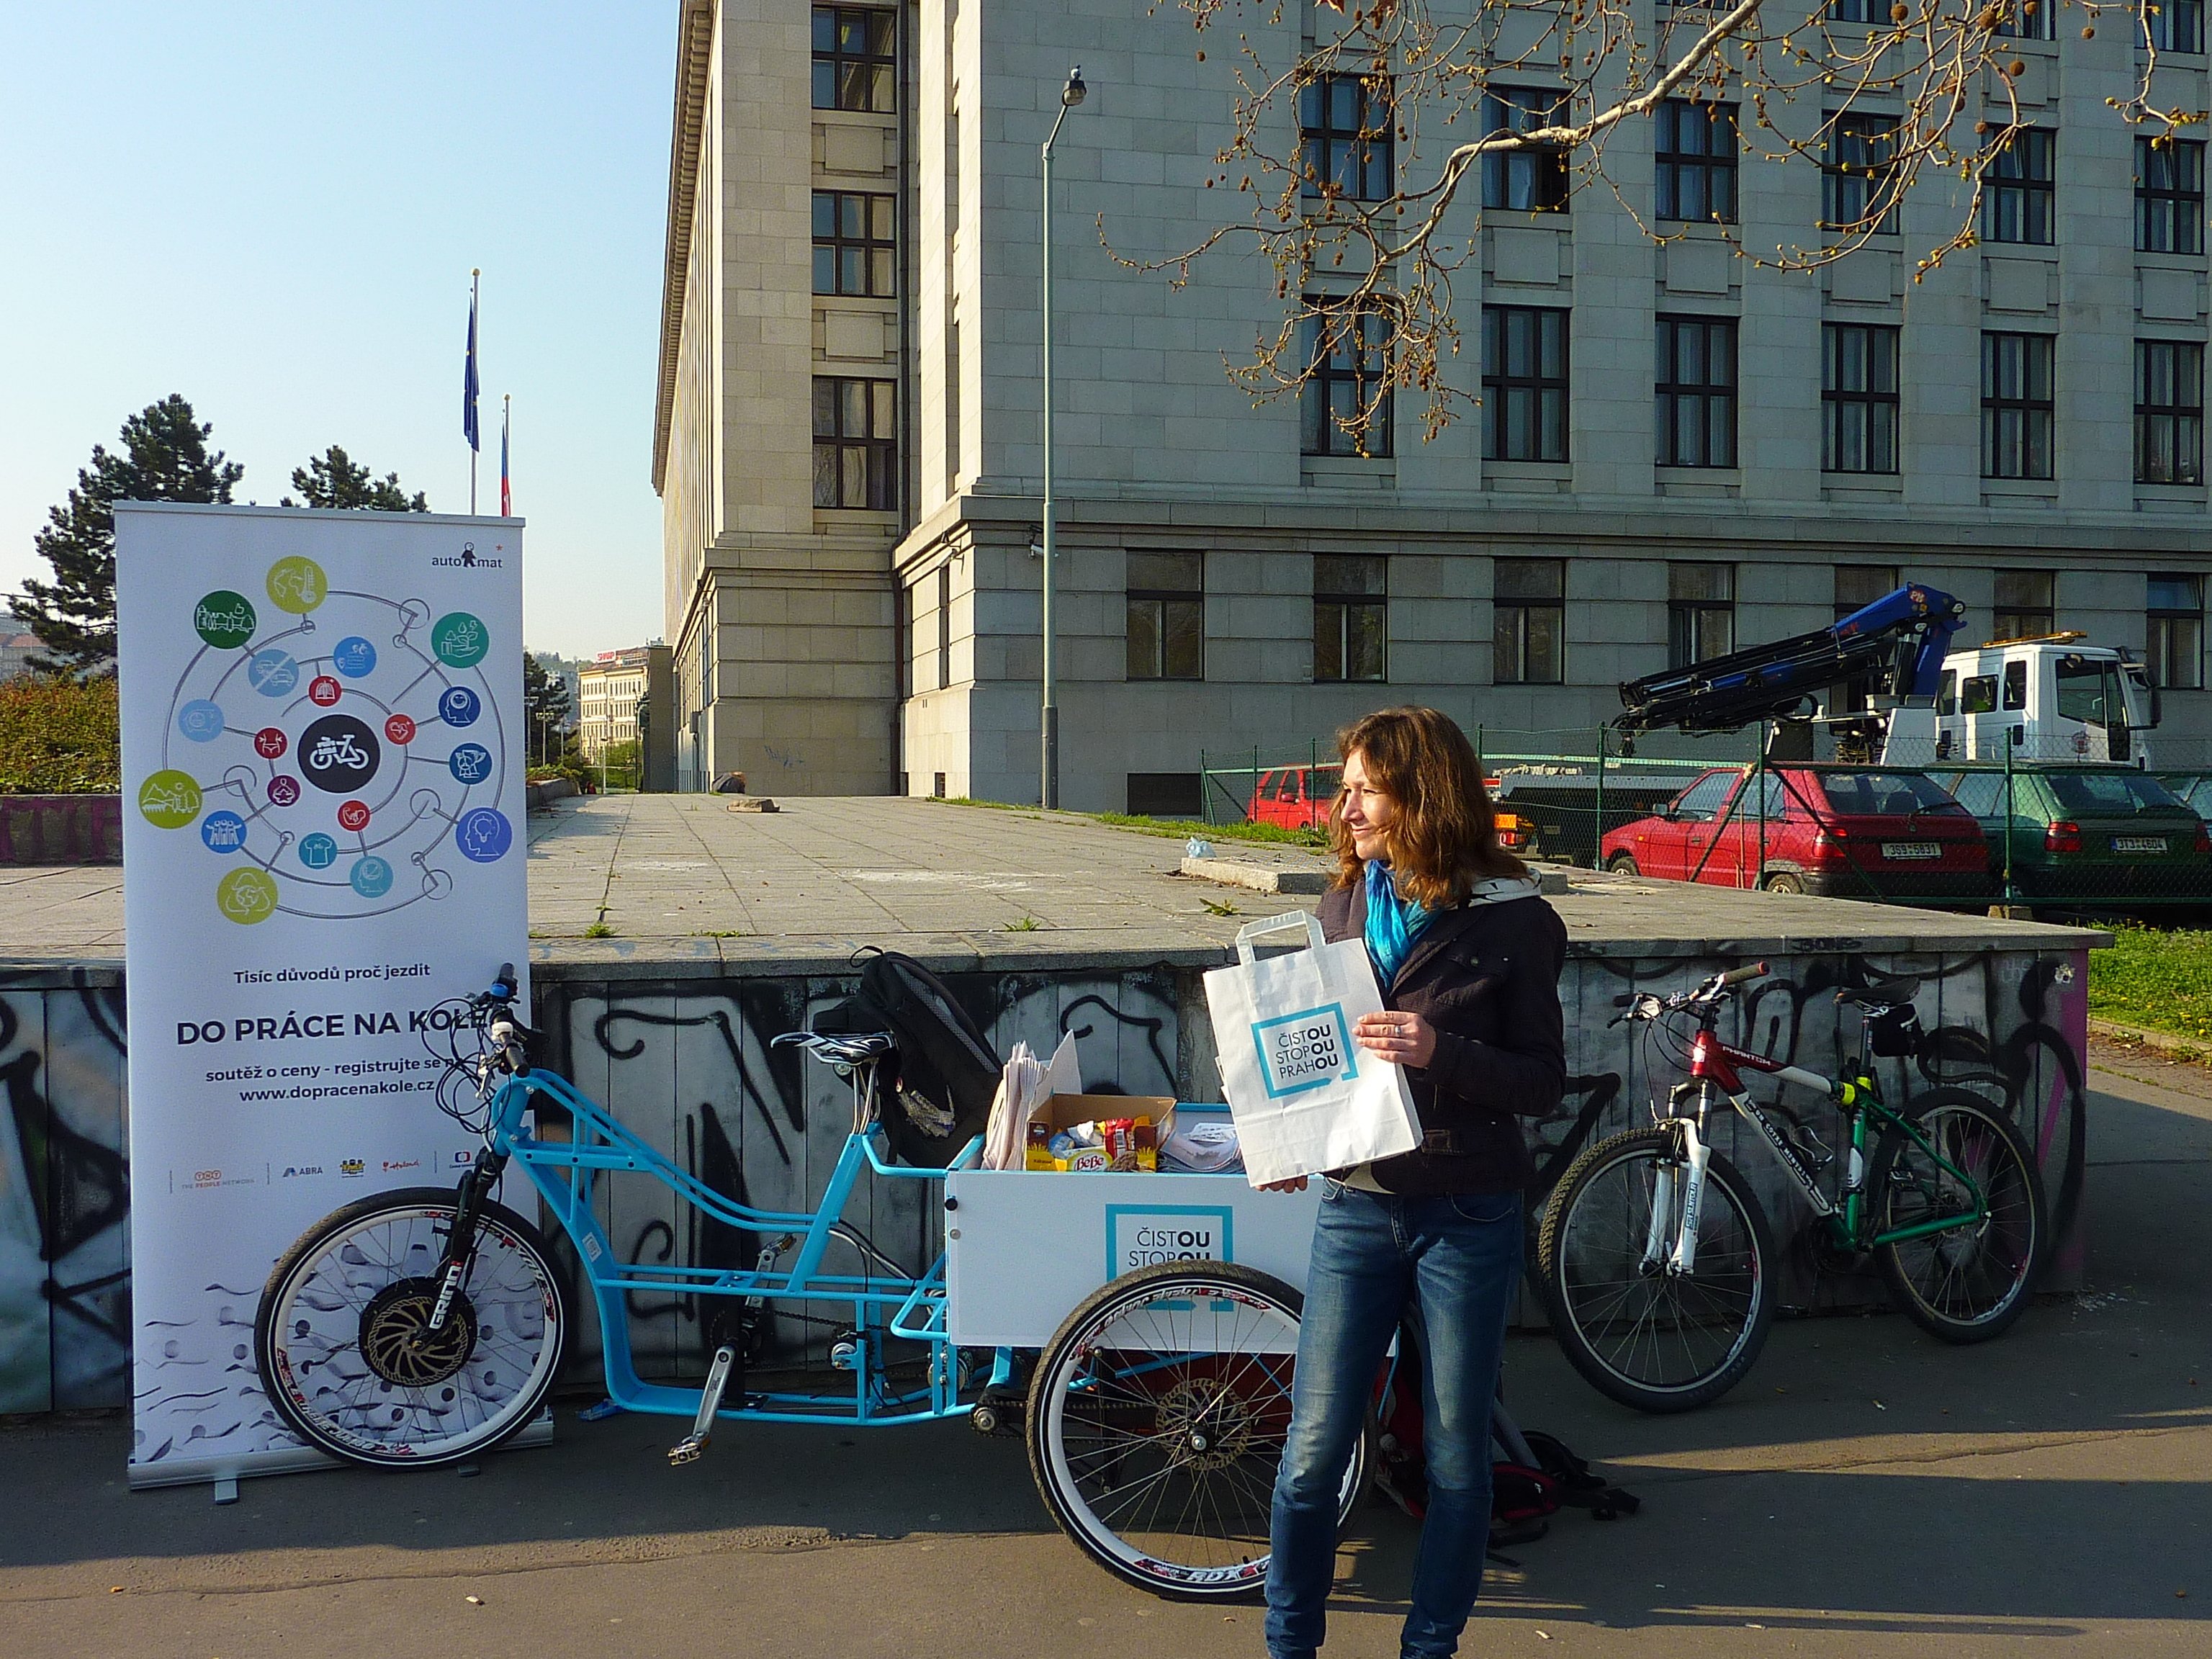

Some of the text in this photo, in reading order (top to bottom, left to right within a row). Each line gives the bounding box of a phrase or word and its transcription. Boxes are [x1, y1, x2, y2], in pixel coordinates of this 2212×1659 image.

[432, 556, 503, 568] auto mat
[233, 963, 431, 984] Tisíc důvodů proč jezdit
[177, 1020, 225, 1045] DO
[235, 1010, 345, 1042] PRÁCE
[354, 1012, 400, 1035] NA
[1278, 1024, 1331, 1048] ČISTOU
[1275, 1039, 1335, 1064] STOPOU
[1722, 1046, 1771, 1066] PHANTOM
[205, 1066, 262, 1082] soutěž
[266, 1068, 276, 1079] o
[281, 1064, 320, 1082] ceny
[335, 1057, 421, 1076] registrujte
[424, 1059, 441, 1069] se
[1279, 1053, 1339, 1079] PRAHOU
[239, 1079, 435, 1102] www.dopracenakole.cz
[299, 1166, 323, 1176] ABRA
[1076, 1155, 1105, 1172] BeBe
[195, 1170, 221, 1181] TNT
[1137, 1227, 1210, 1248] ČISTOU
